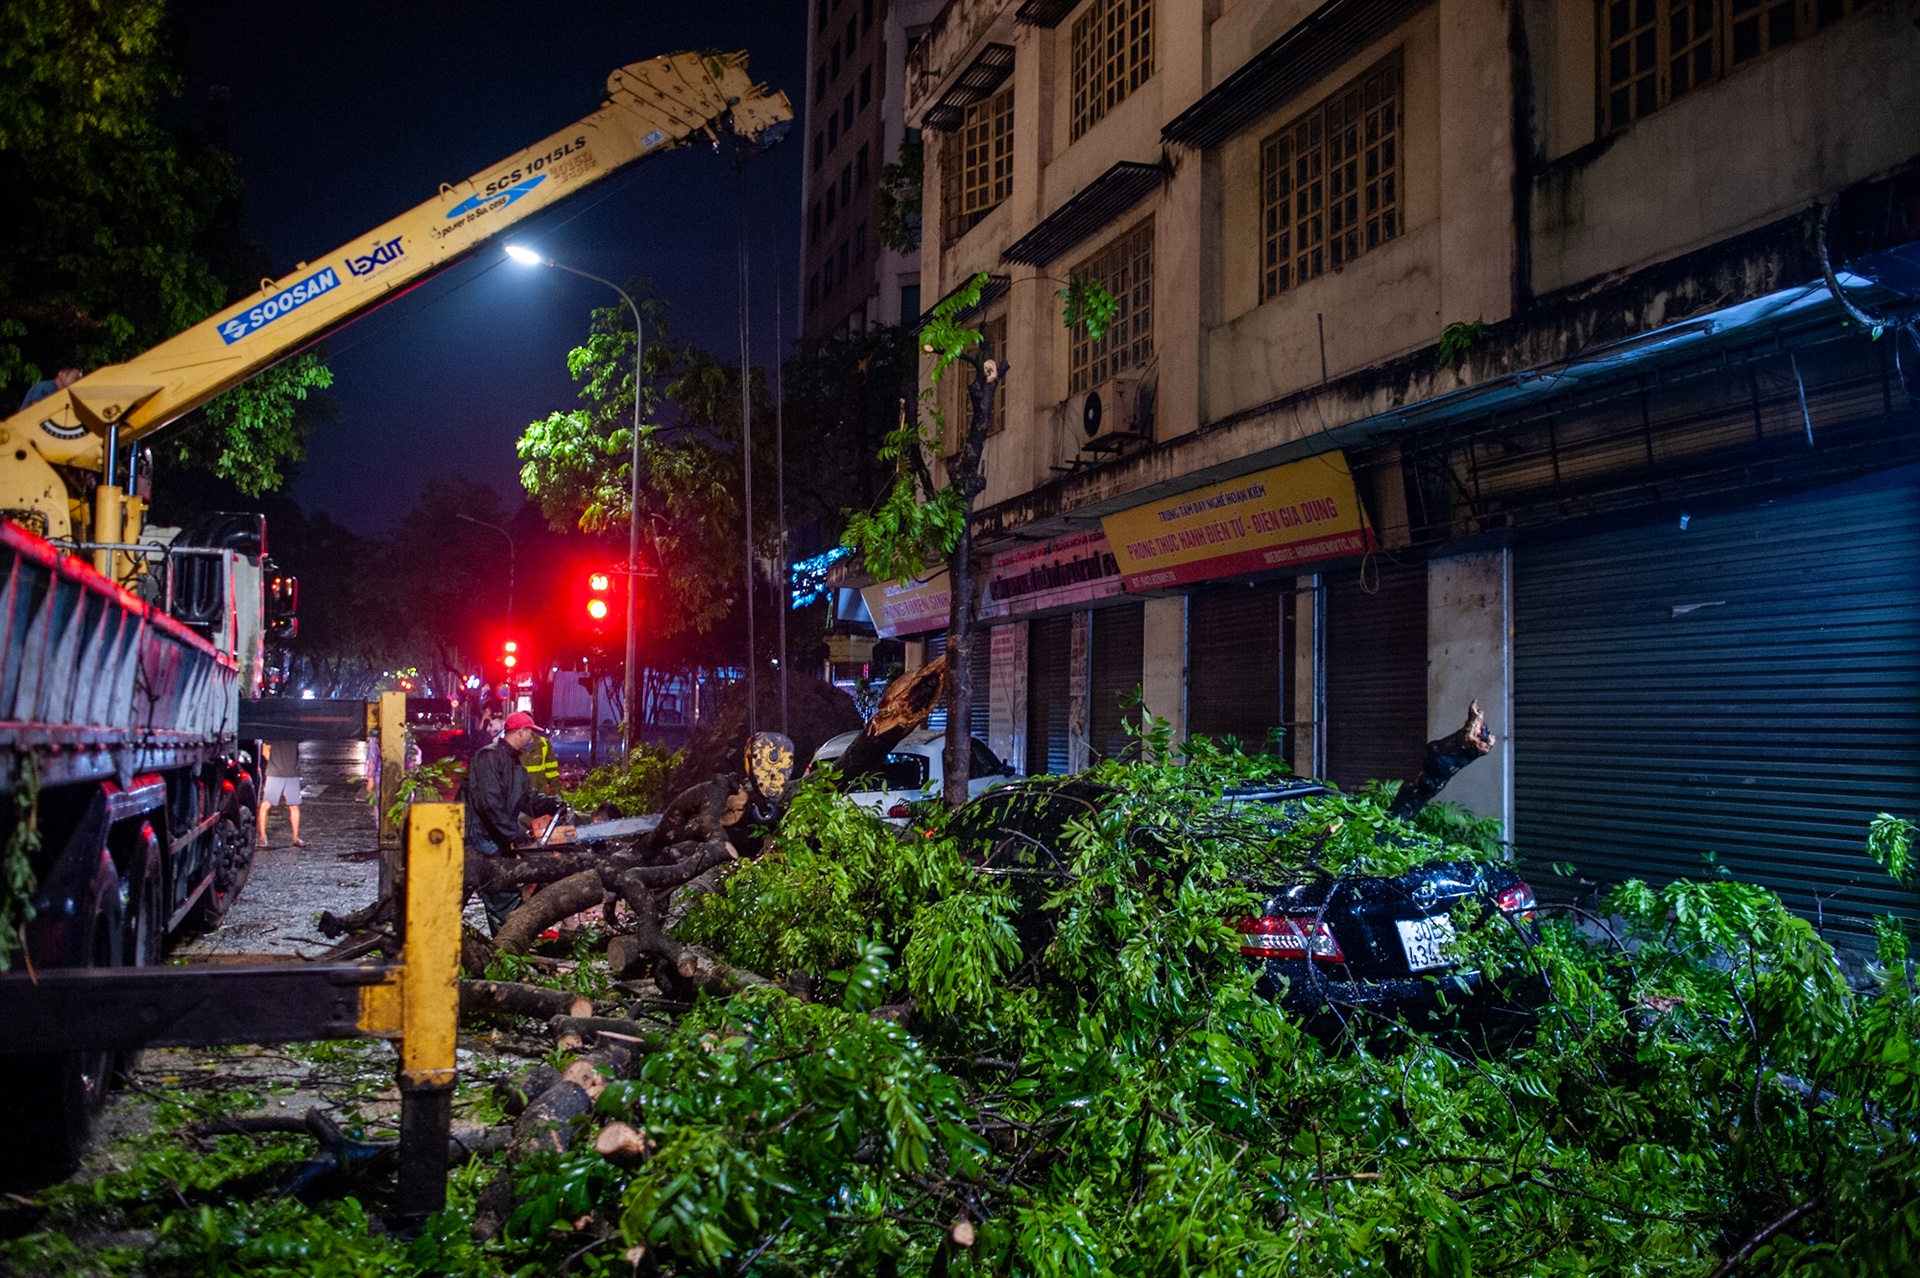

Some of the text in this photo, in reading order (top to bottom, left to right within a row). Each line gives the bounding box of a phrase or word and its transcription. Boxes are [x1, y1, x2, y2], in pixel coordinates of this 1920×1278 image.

[485, 135, 586, 197] SCS 1015LS
[466, 213, 476, 223] to
[248, 269, 335, 328] SOOSAN
[1157, 507, 1180, 523] TRUNG
[1279, 505, 1303, 529] GIA
[1300, 497, 1339, 527] DỤNG
[928, 590, 951, 611] SINH
